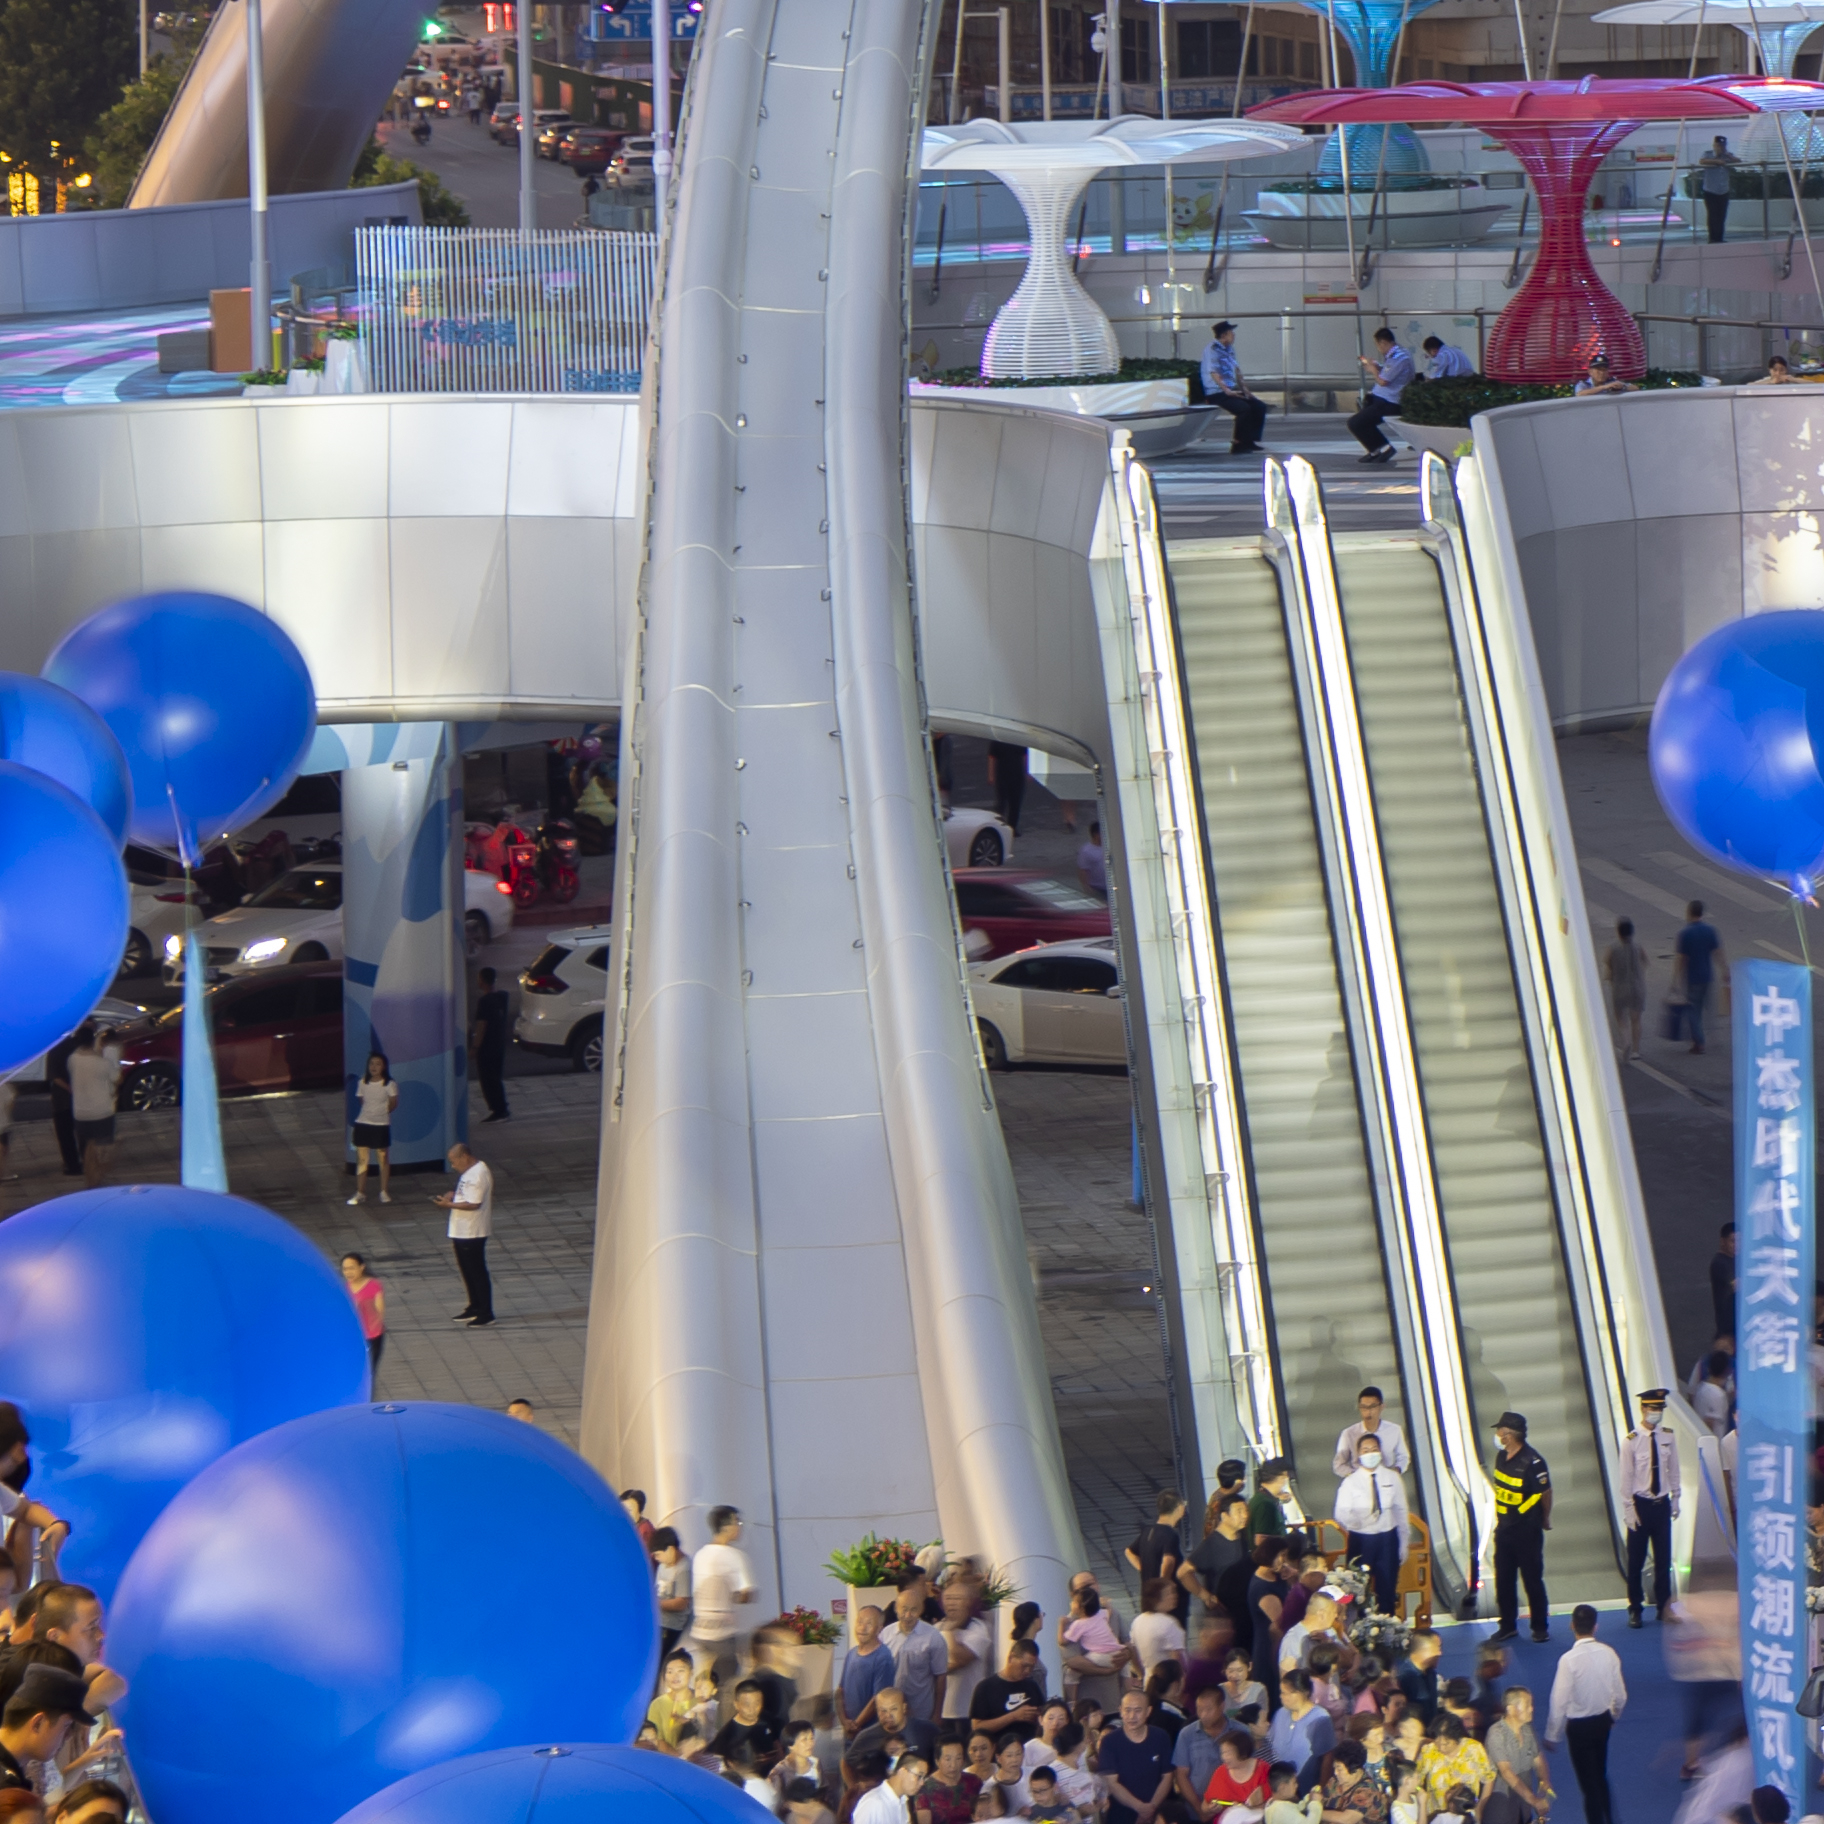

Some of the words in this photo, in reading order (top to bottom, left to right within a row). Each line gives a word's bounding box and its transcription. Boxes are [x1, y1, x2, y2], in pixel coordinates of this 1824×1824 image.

[1748, 986, 1802, 1375] 中杰时代天街
[1747, 1444, 1800, 1823] 引领潮流风
